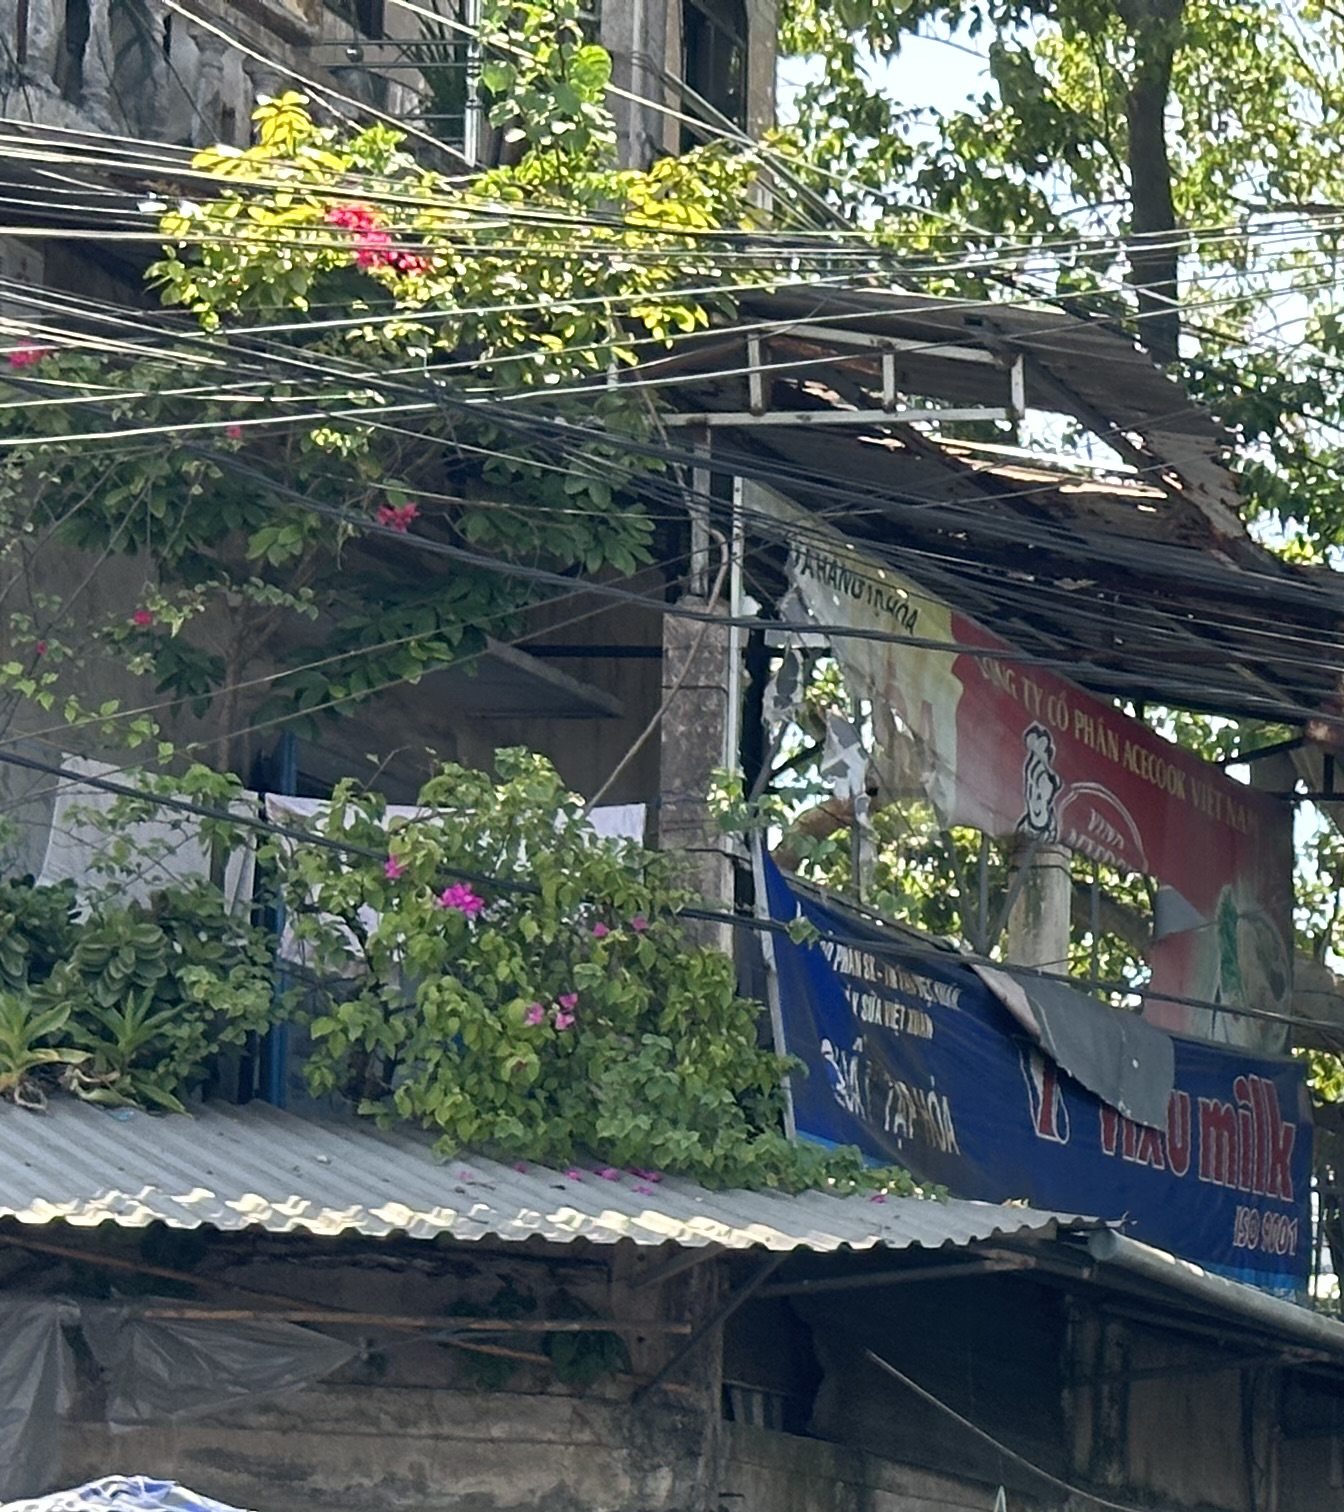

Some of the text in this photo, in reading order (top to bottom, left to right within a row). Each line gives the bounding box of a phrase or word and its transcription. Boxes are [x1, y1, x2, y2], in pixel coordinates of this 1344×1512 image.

[1123, 739, 1186, 800] ACECOOK
[1198, 1074, 1297, 1203] milk
[1232, 1205, 1260, 1250] ISO
